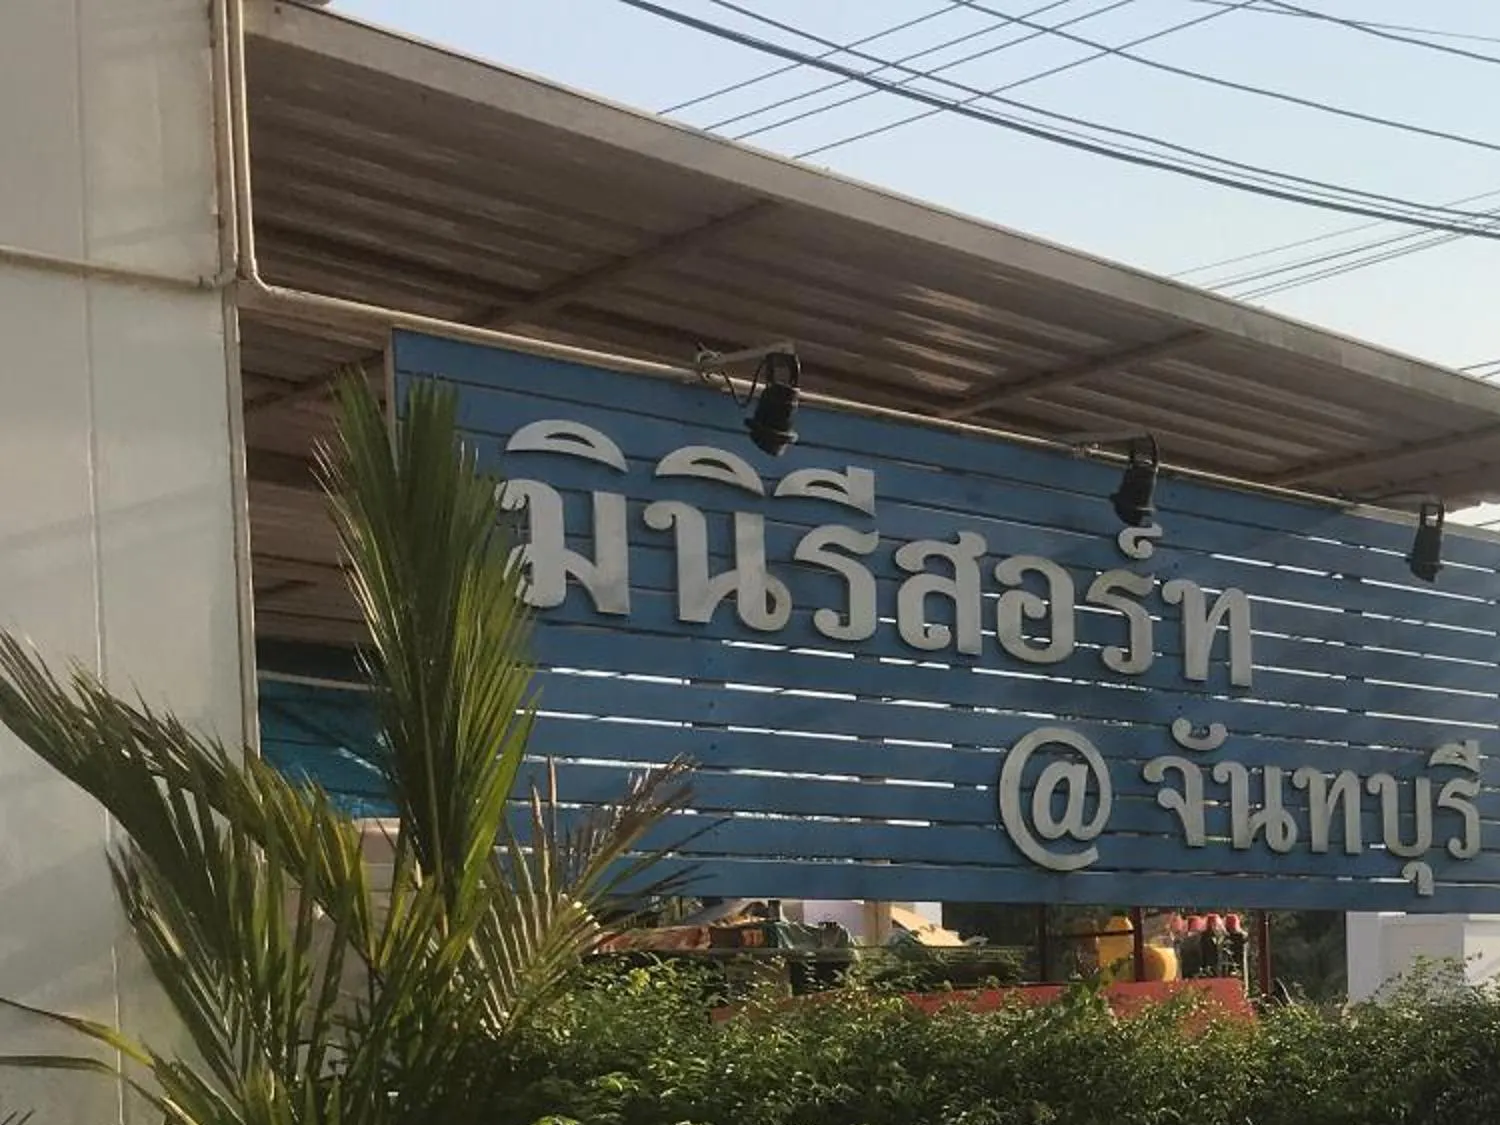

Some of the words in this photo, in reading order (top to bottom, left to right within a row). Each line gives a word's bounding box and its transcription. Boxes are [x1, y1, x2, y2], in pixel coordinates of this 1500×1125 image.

[495, 418, 1253, 688] มินิรีสอร์ท
[999, 726, 1113, 872] @
[1143, 716, 1484, 897] จันทบุรี
